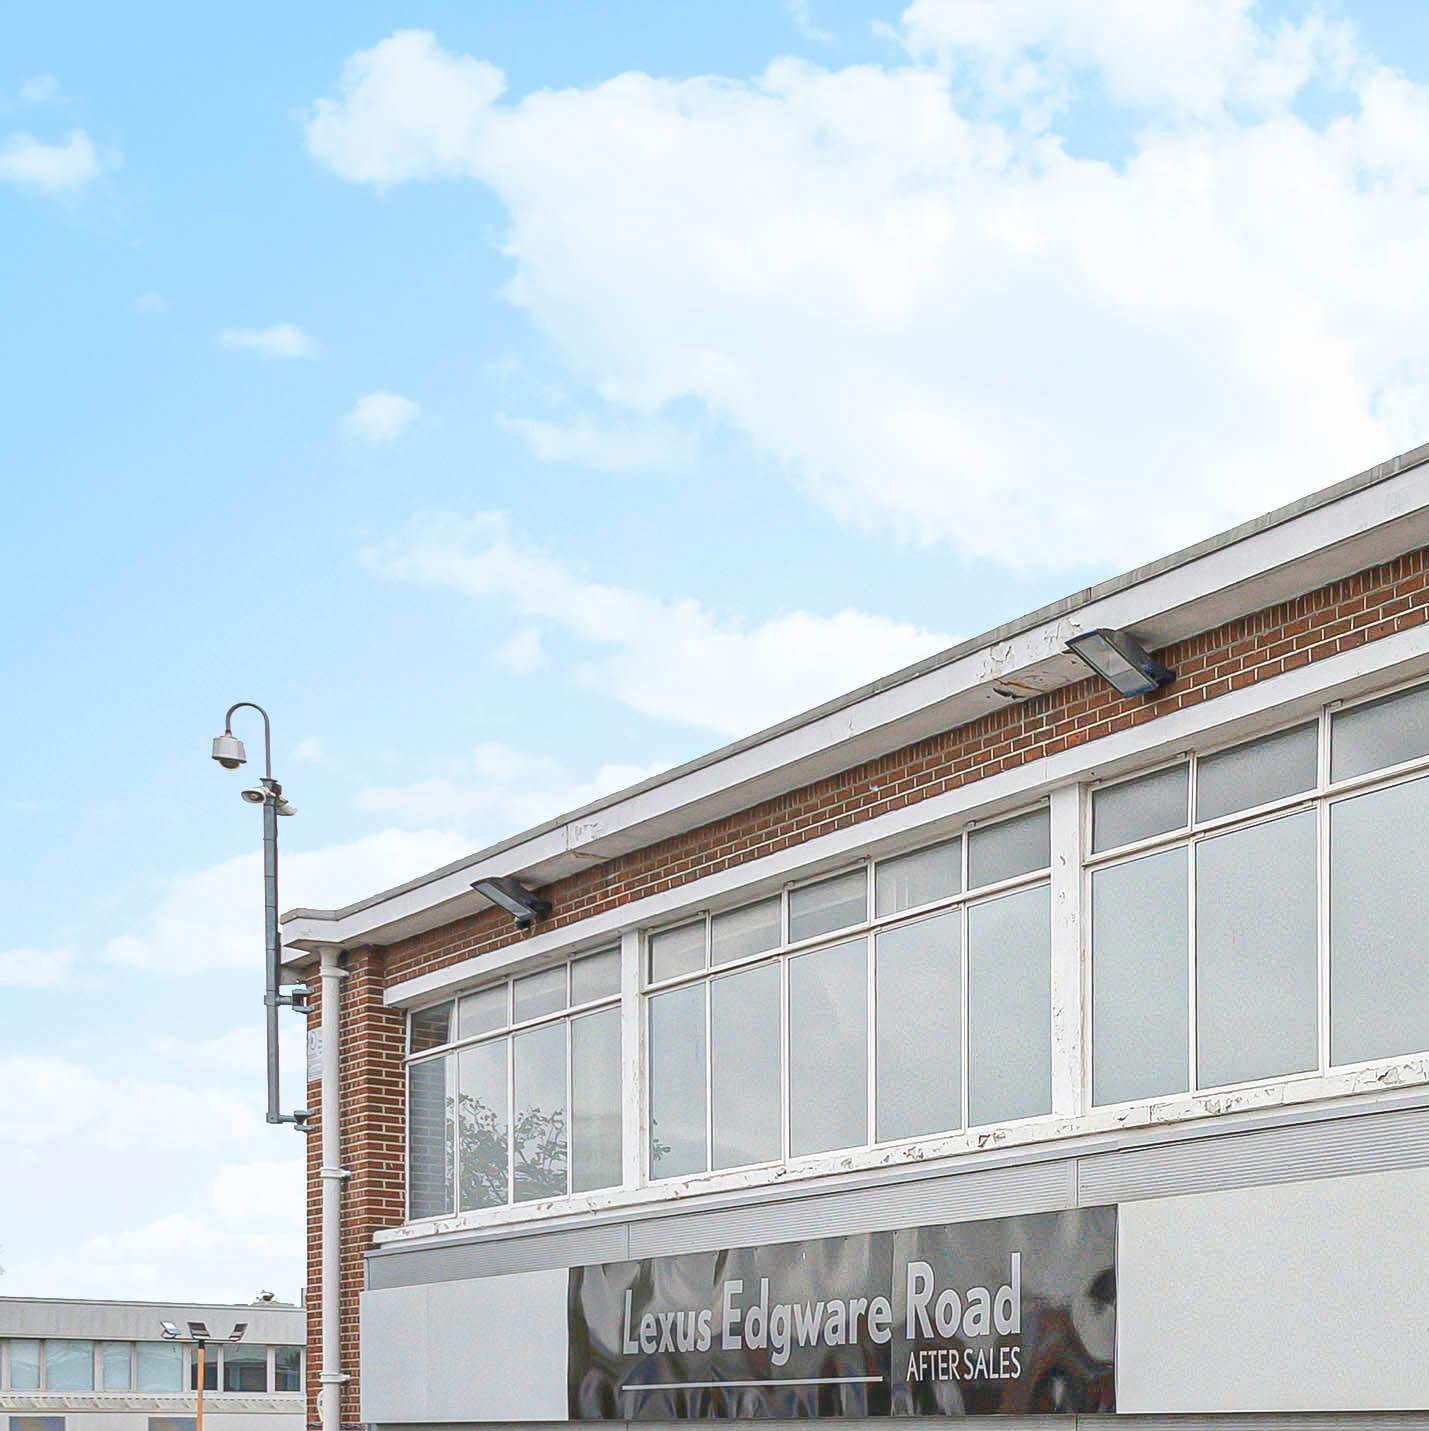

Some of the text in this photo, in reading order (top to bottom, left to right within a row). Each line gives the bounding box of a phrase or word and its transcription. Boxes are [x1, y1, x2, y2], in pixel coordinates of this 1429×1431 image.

[622, 1252, 1022, 1367] Lexus Edgware Road
[906, 1346, 1022, 1383] AFTER SALES
